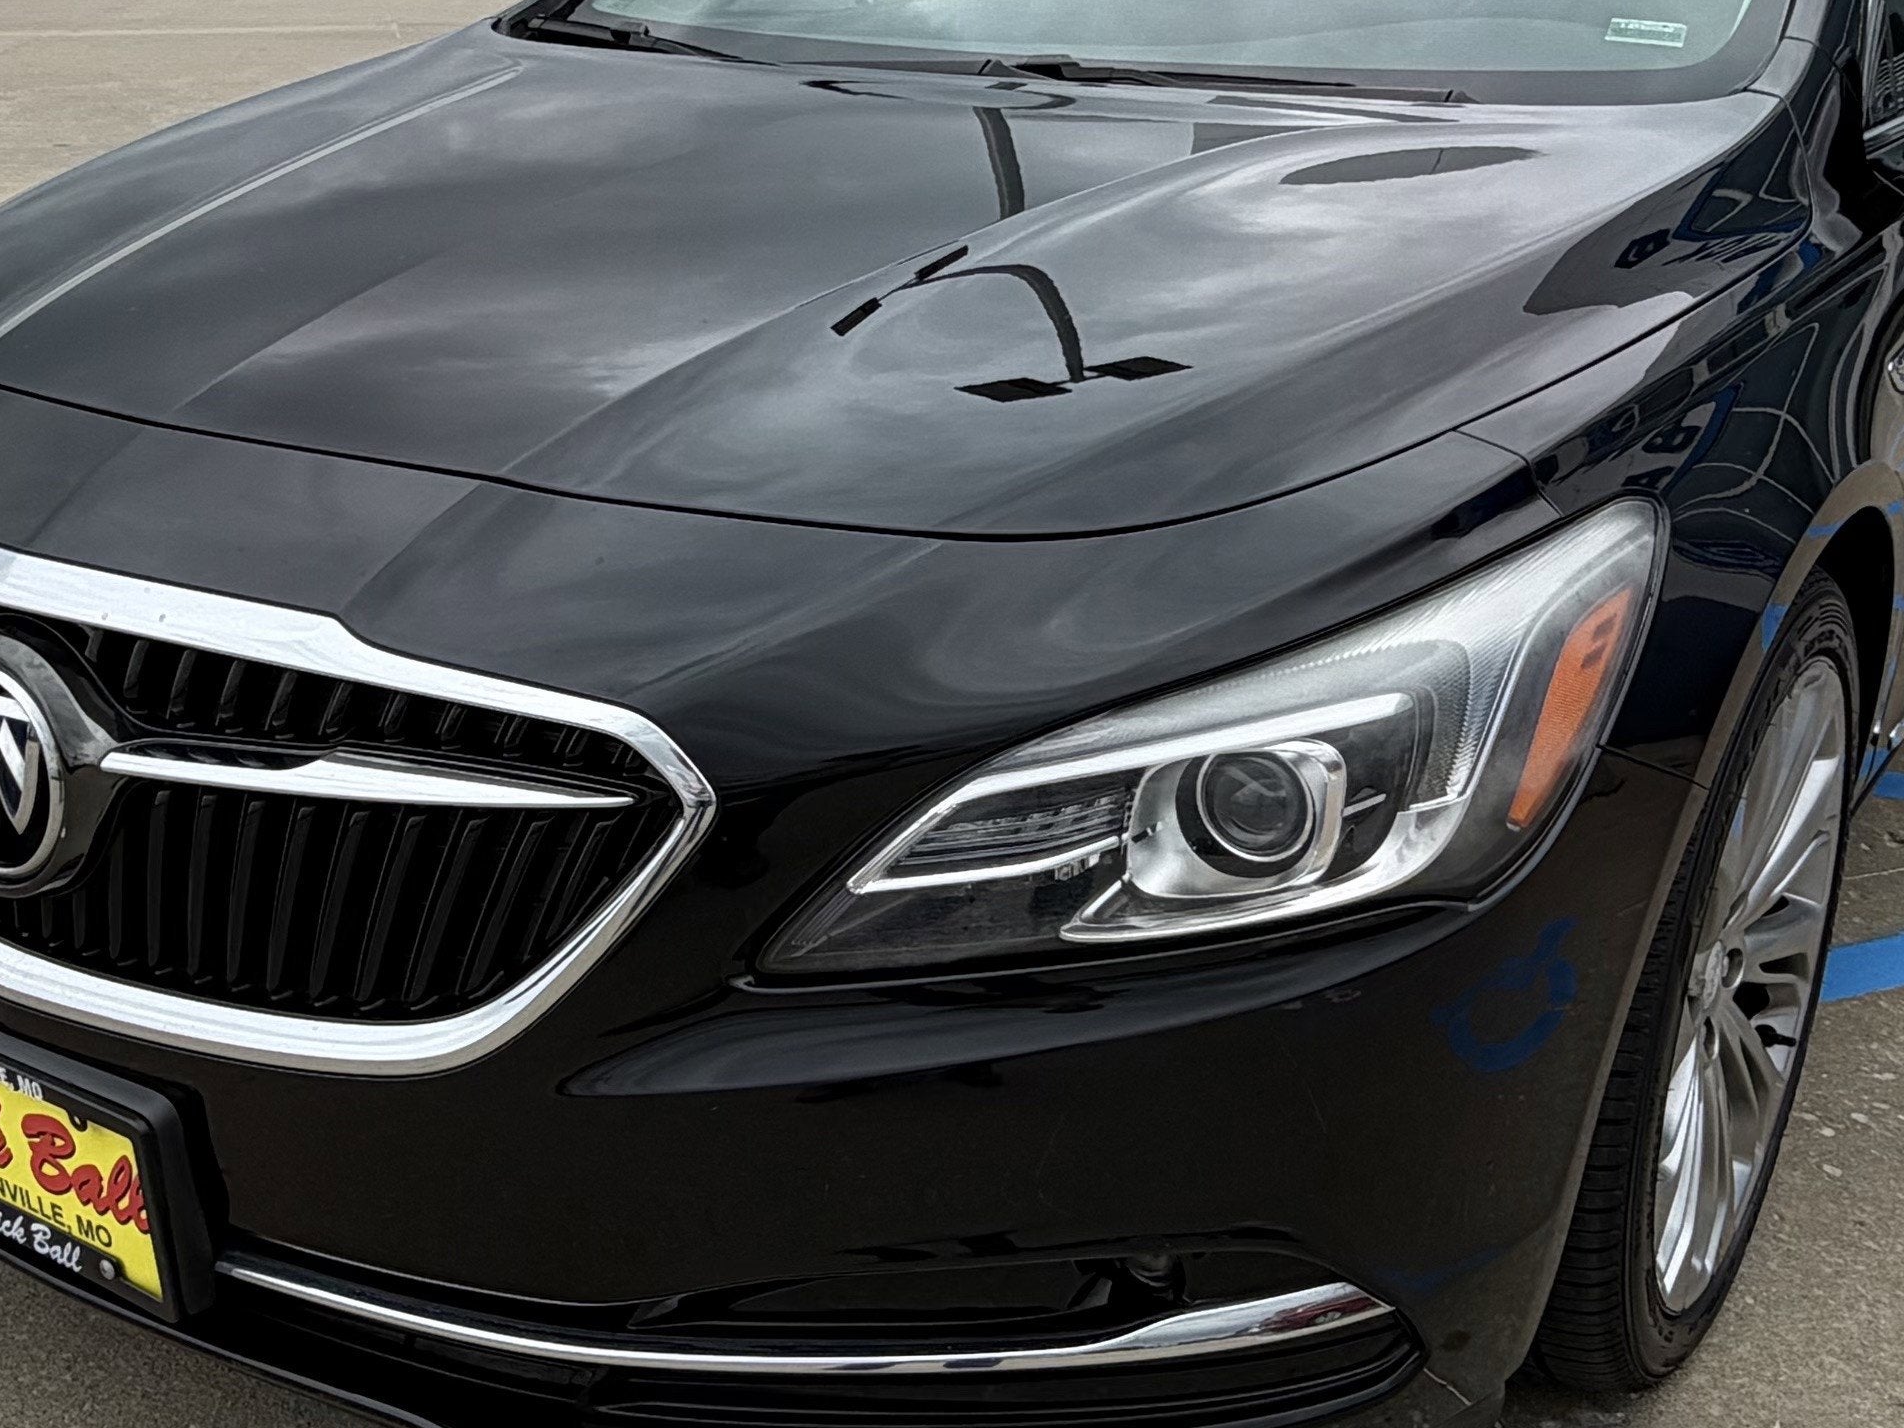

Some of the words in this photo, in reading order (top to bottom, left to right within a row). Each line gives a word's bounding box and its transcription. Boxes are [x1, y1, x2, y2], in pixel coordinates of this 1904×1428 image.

[16, 1075, 44, 1101] MO
[21, 1113, 151, 1234] Ball
[30, 1222, 82, 1273] Ball
[75, 1214, 113, 1248] MO
